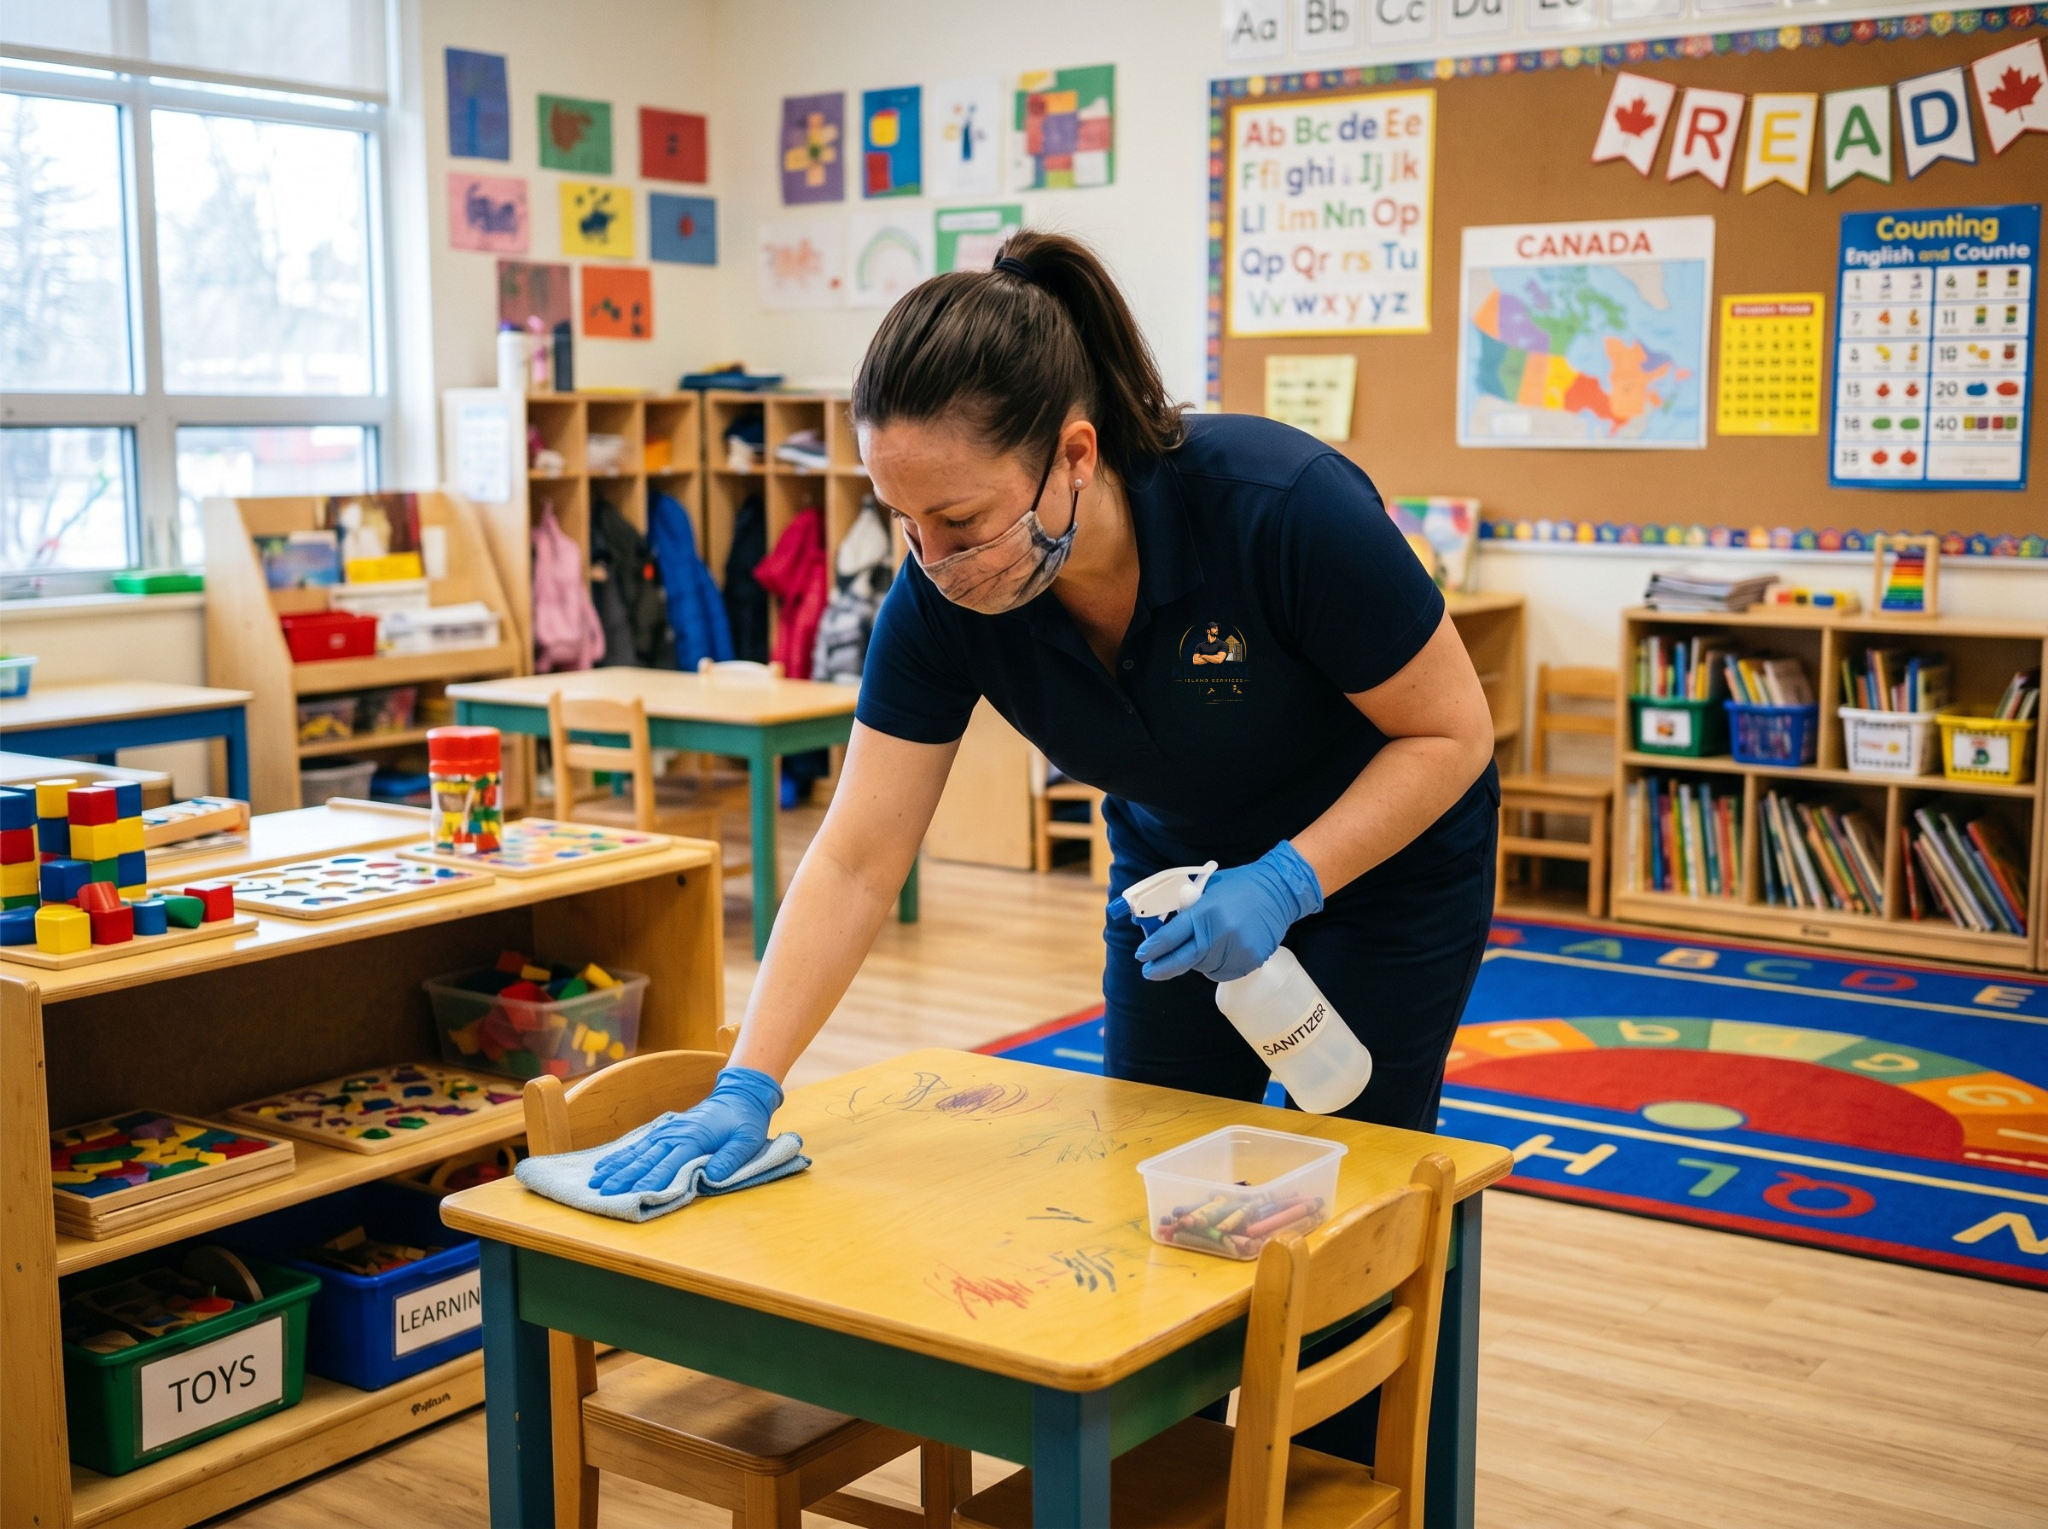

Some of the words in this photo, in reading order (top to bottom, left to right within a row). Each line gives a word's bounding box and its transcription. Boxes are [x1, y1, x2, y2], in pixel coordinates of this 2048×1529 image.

[1231, 12, 1277, 44] Aa
[1306, 0, 1350, 35] Bb
[1376, 0, 1425, 26] Cc
[1683, 91, 1959, 163] READ
[1516, 229, 1653, 259] CANADA
[1876, 212, 1999, 243] Counting
[1845, 245, 1915, 270] English
[1918, 246, 1950, 262] and
[1954, 241, 2031, 262] Counte
[1262, 1002, 1327, 1056] SANITIZER
[168, 1354, 257, 1413] TOYS
